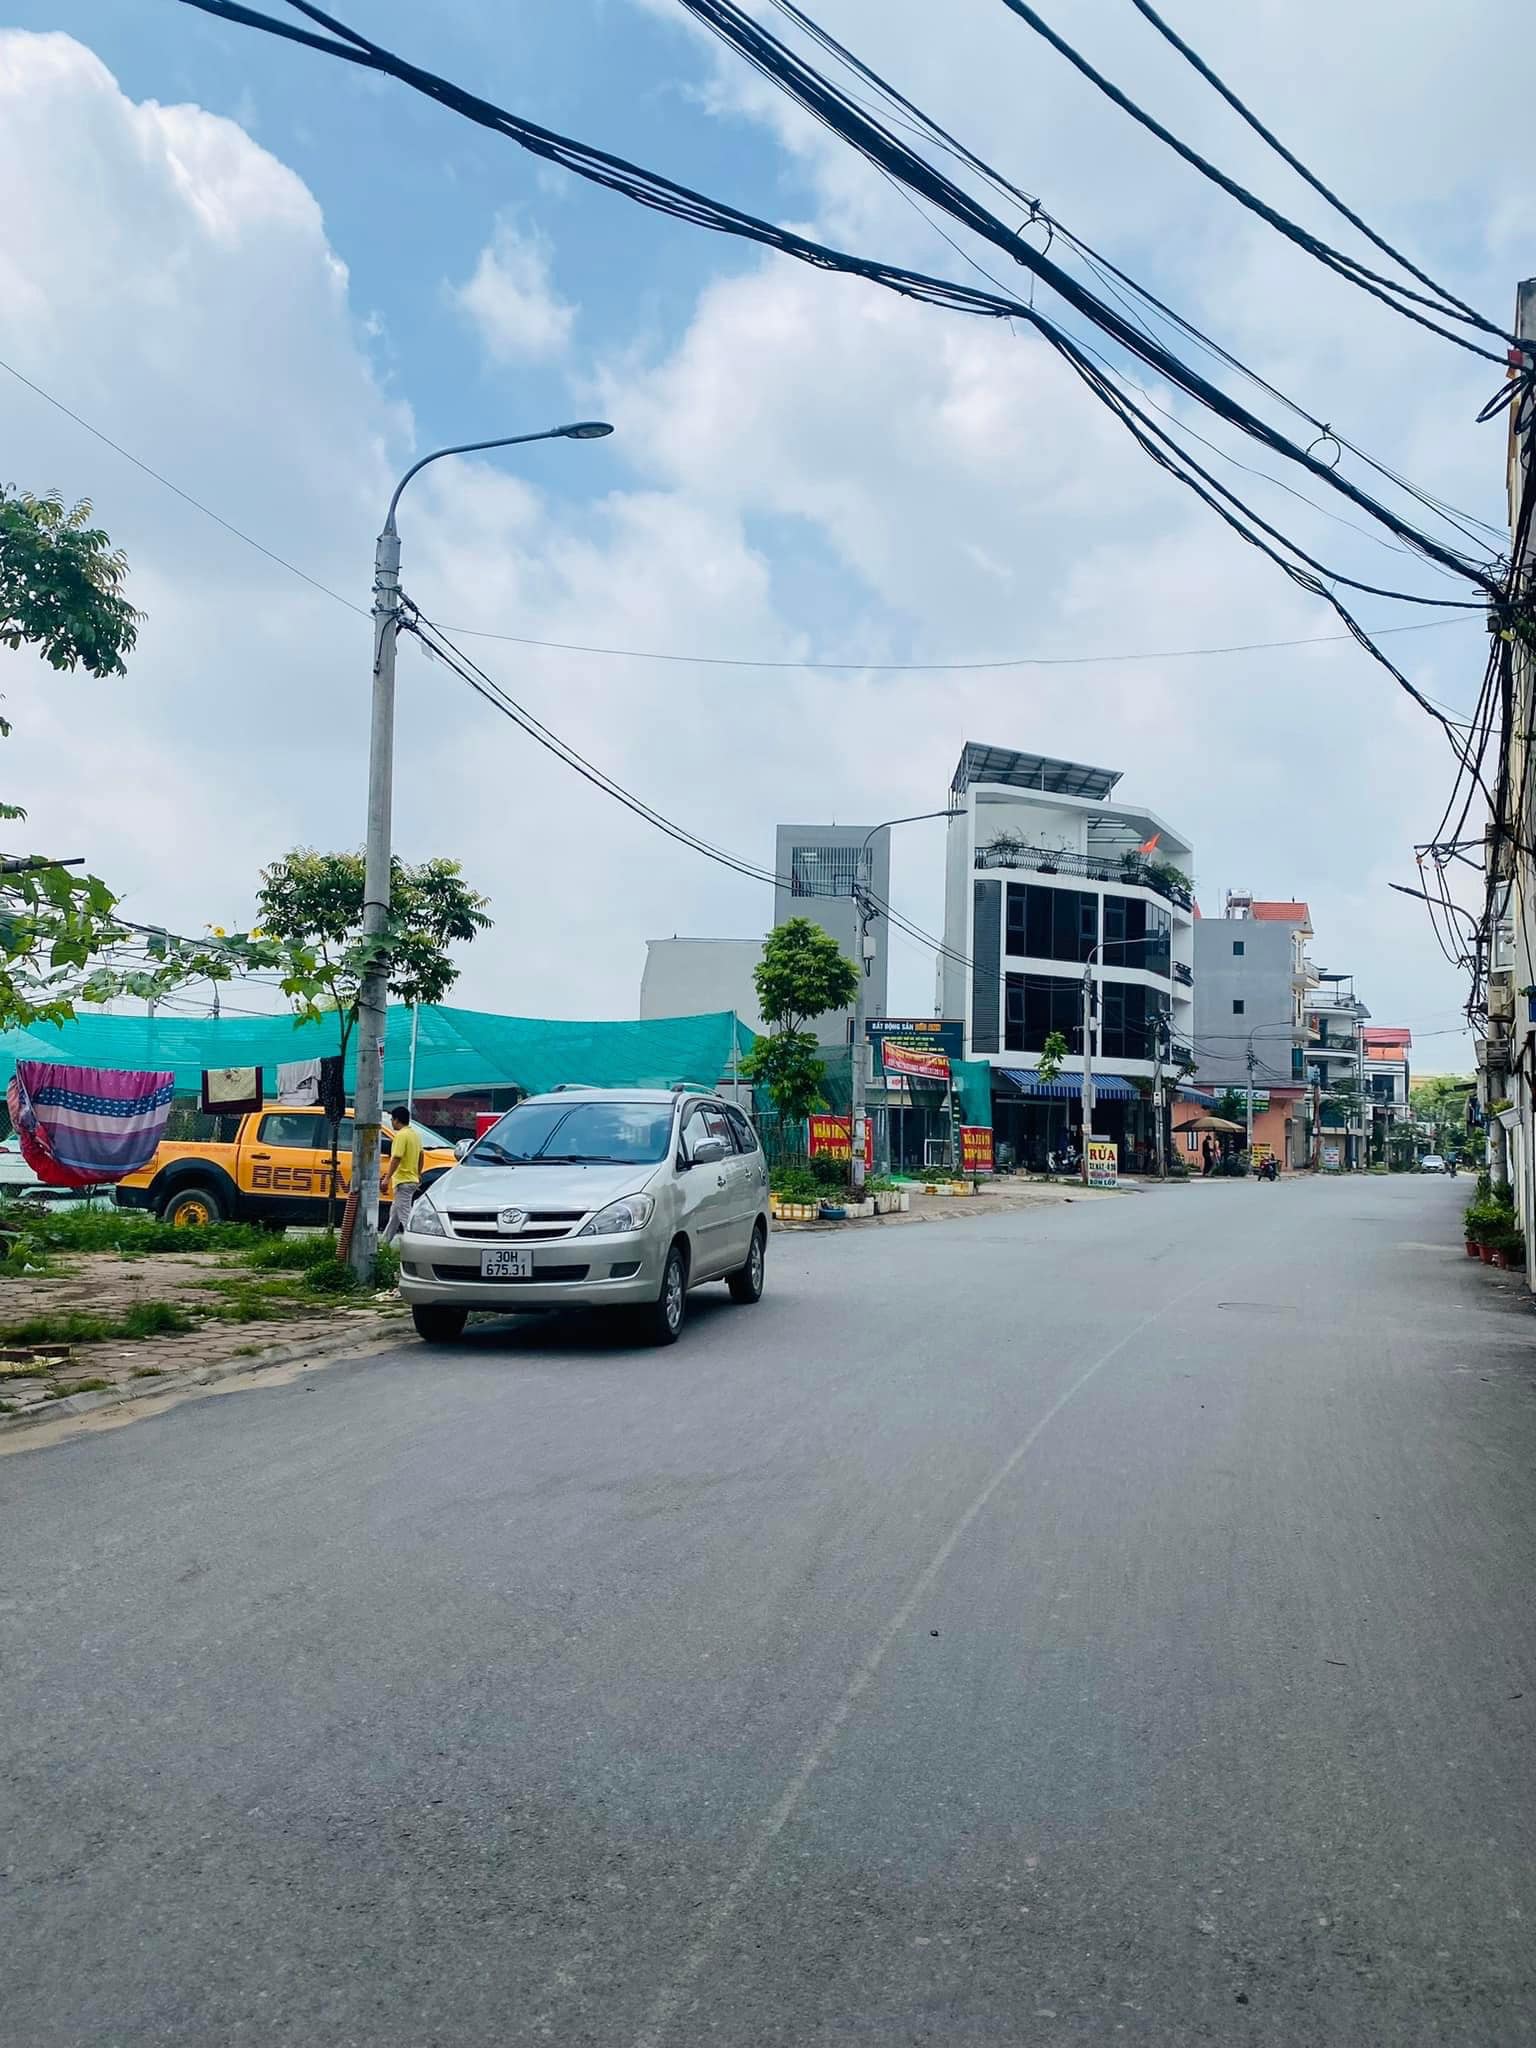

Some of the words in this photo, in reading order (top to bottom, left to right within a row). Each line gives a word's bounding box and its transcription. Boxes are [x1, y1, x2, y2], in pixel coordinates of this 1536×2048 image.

[1089, 1145, 1115, 1161] RỬA
[495, 1251, 519, 1264] 30H
[486, 1264, 527, 1277] 675.31
